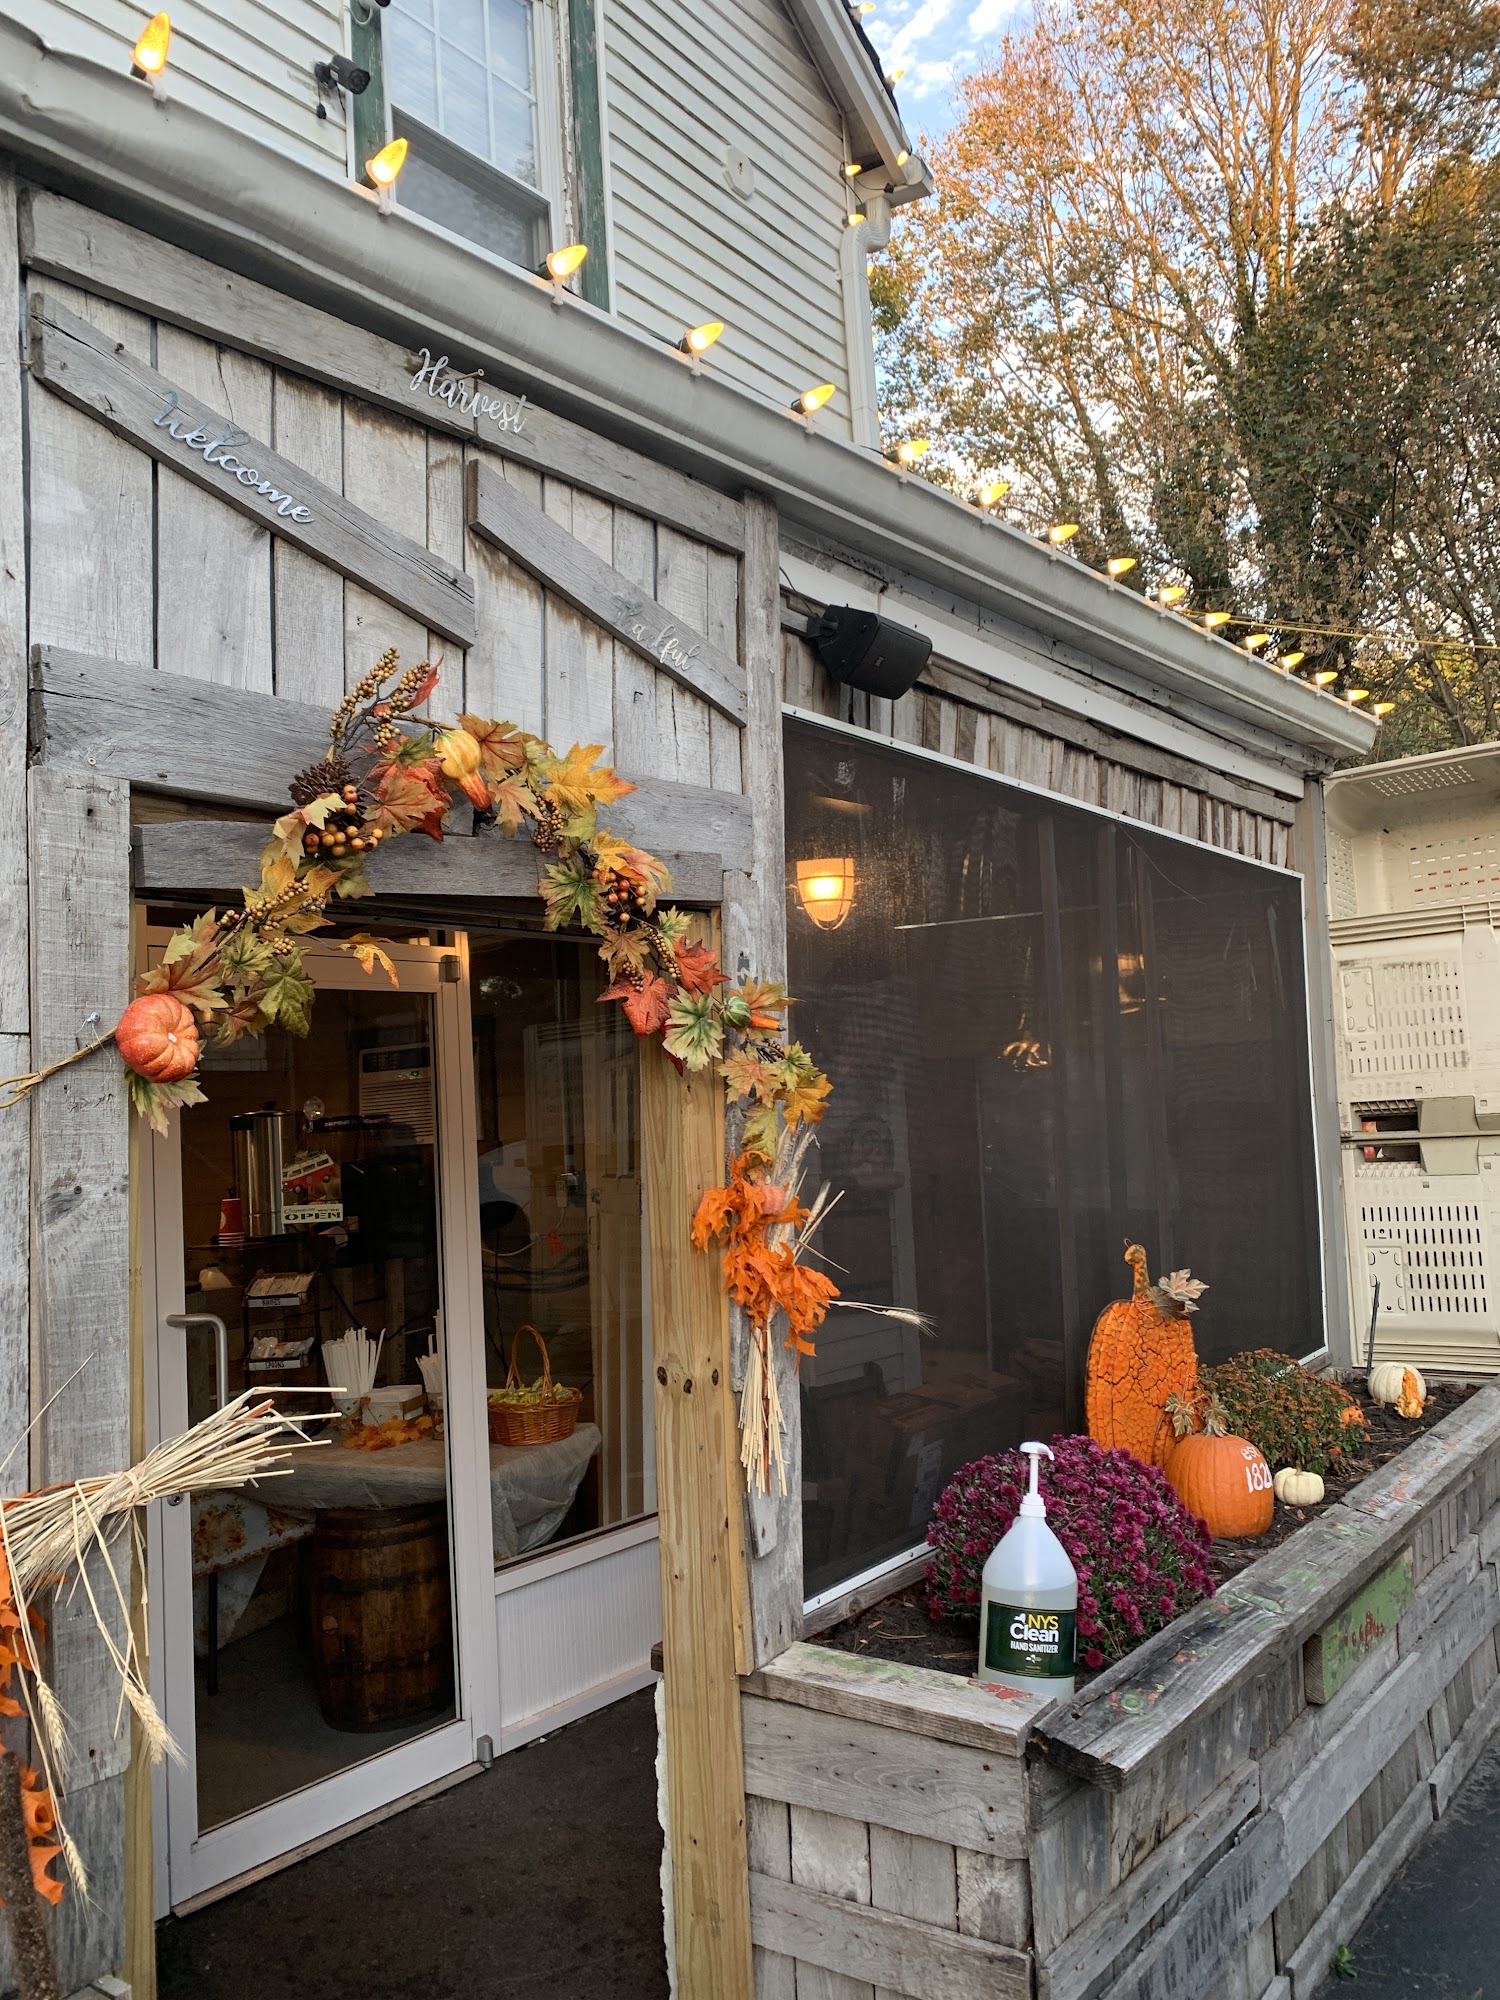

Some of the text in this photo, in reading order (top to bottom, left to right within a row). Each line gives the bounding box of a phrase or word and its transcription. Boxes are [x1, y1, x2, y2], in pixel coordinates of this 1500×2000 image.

[409, 347, 533, 433] Harvest
[153, 389, 315, 524] Welcome
[284, 1211, 341, 1221] OPEN
[1028, 1613, 1059, 1630] NYS
[1009, 1622, 1059, 1643] Clean
[1010, 1640, 1059, 1654] HAND SANITIZER
